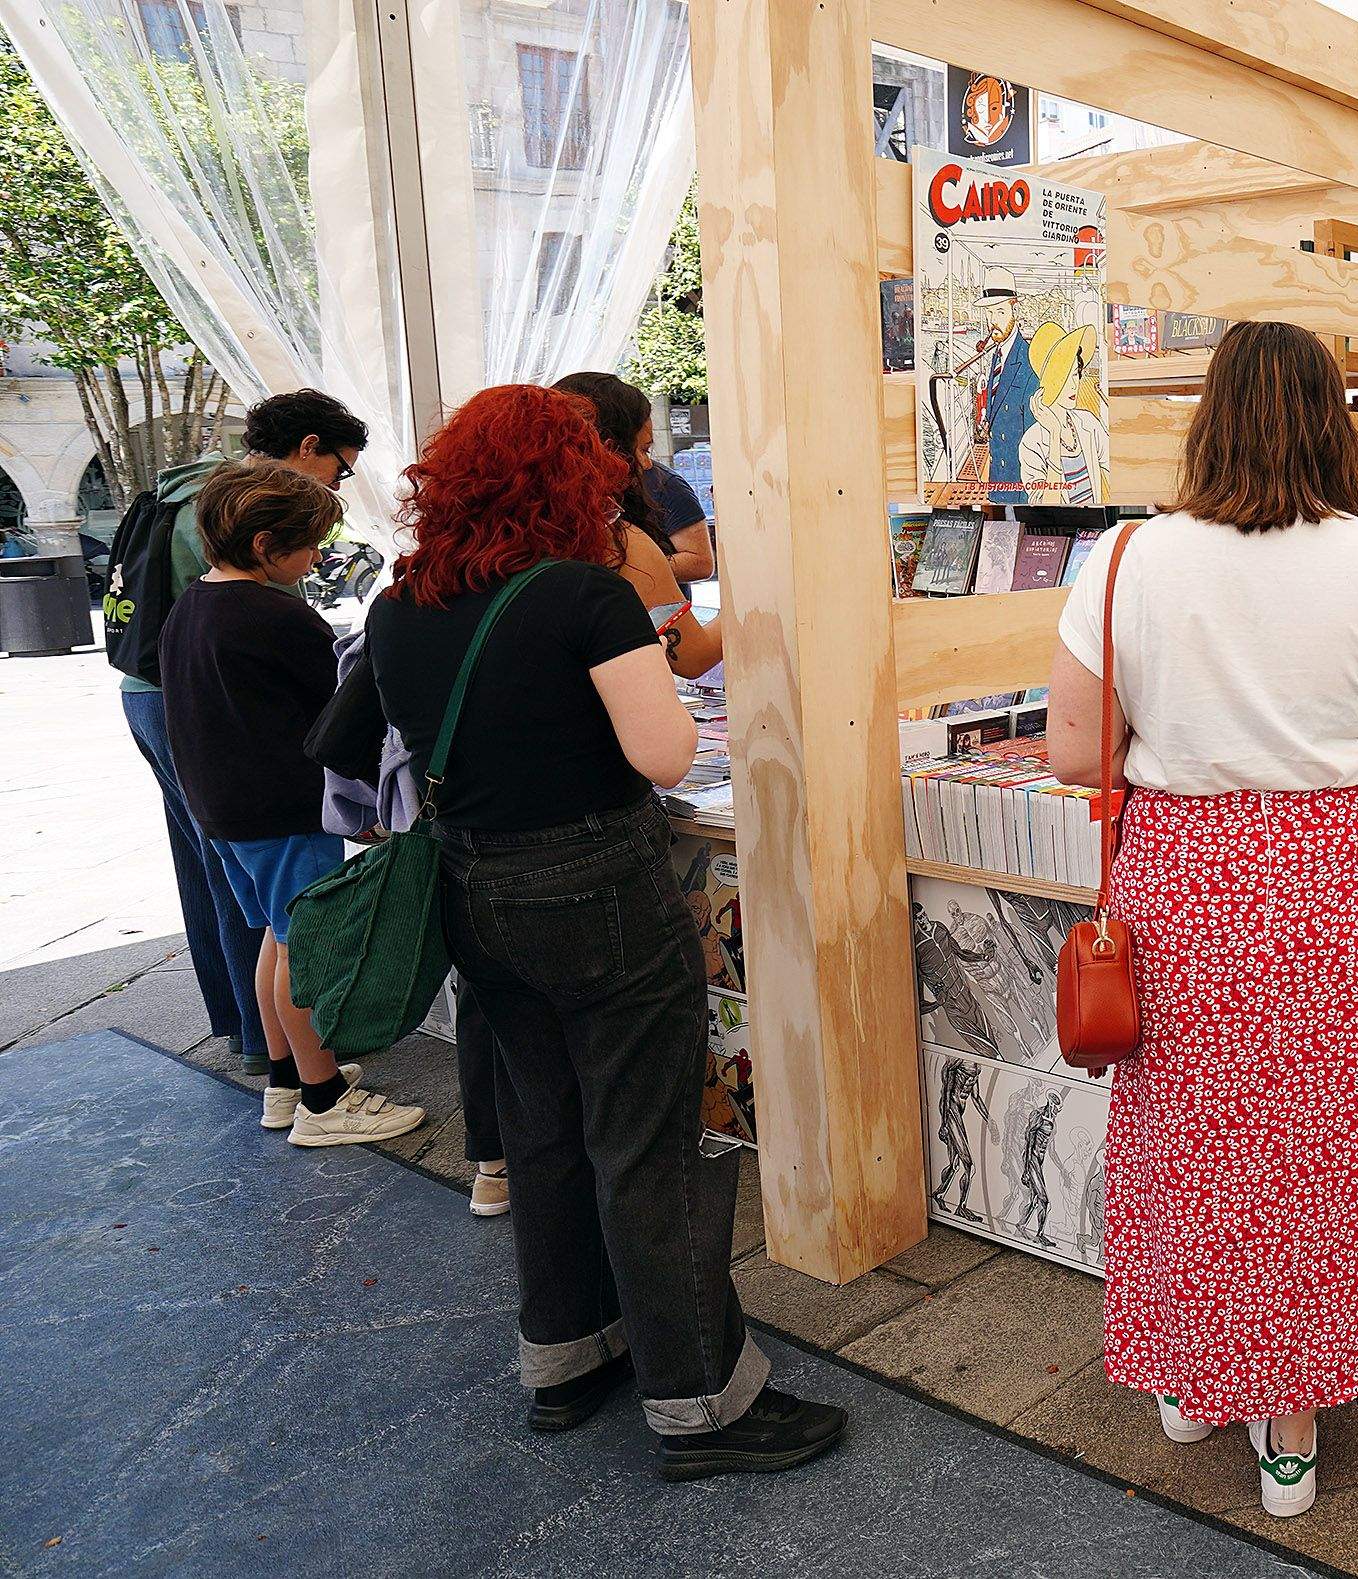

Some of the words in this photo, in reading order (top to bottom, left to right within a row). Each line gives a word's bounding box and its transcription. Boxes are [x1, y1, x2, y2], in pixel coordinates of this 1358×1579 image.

[928, 163, 1031, 228] CAIRO
[1042, 188, 1053, 198] LA
[1055, 192, 1085, 206] PUERTA
[1042, 199, 1053, 208] DE
[1054, 202, 1088, 216] ORIENTE
[1042, 209, 1053, 219] DE
[1042, 220, 1079, 234] VITTORIO
[935, 235, 950, 250] 39
[1042, 230, 1080, 245] GIARDINO
[1171, 317, 1217, 338] BLACKSAD
[979, 482, 1025, 492] HISTORIAS
